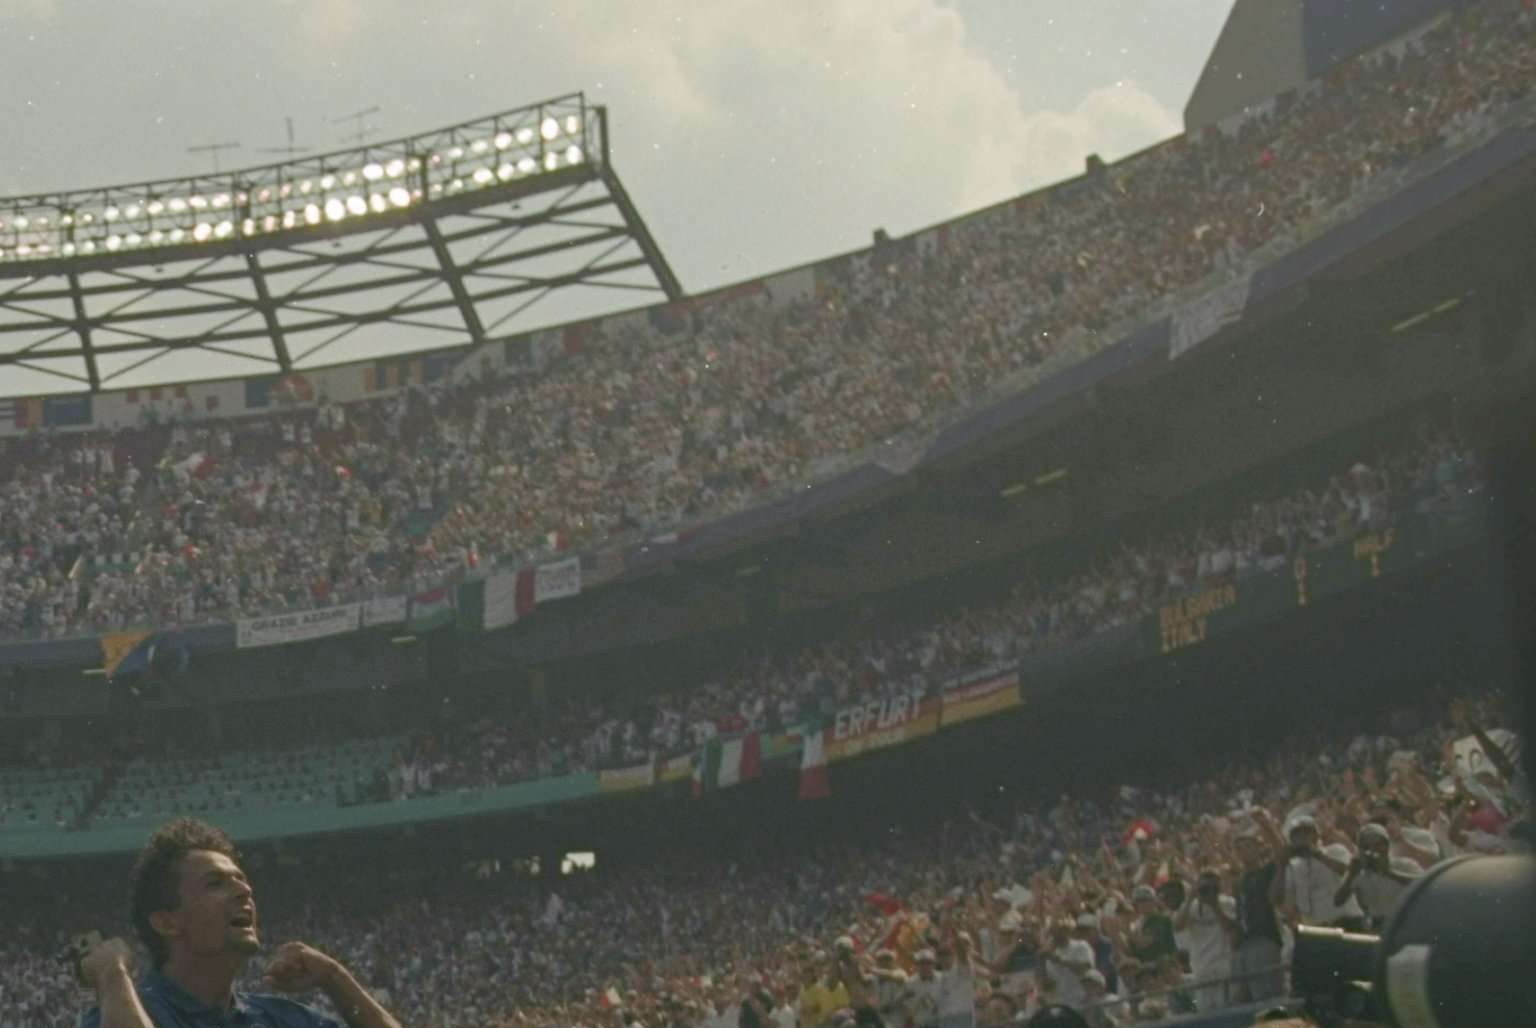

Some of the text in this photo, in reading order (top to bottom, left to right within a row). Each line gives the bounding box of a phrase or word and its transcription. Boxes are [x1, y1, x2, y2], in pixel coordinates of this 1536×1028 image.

[1160, 583, 1237, 629] BULGARIA
[1160, 616, 1207, 653] ITALY
[834, 688, 926, 740] ERFURT
